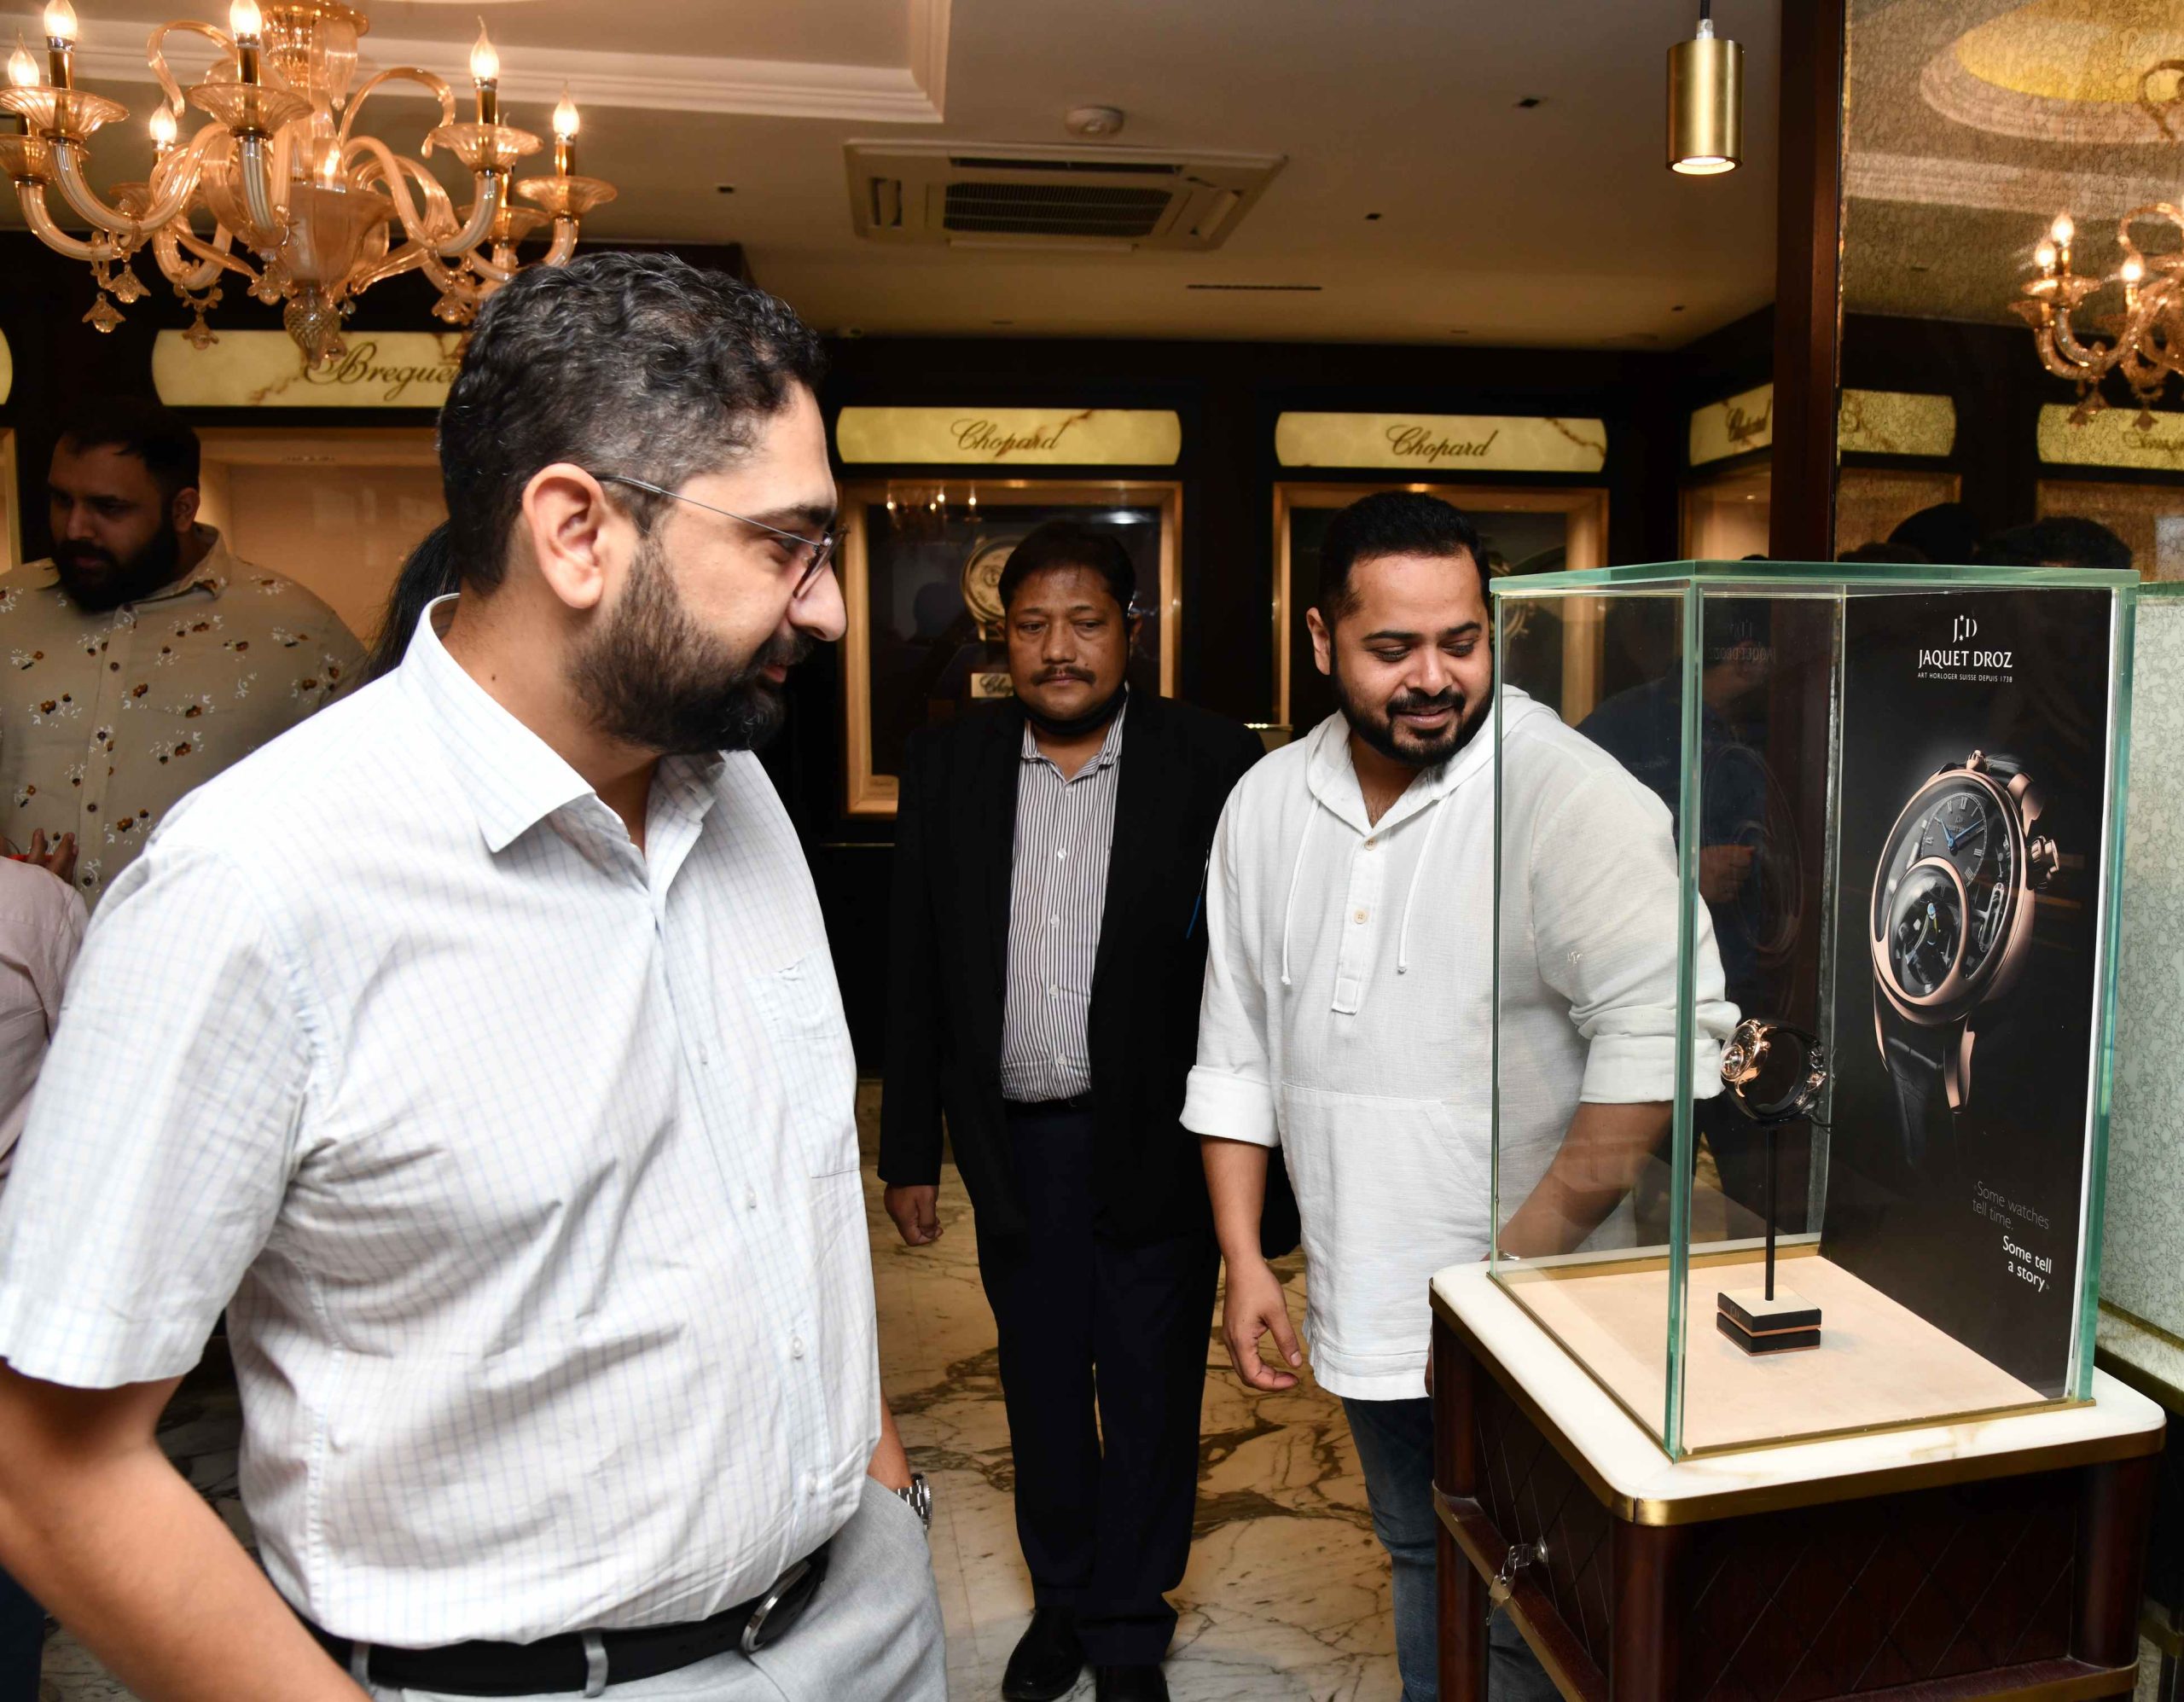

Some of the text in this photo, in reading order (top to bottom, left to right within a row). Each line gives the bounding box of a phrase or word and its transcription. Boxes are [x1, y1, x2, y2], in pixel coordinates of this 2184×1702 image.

[304, 341, 461, 402] Bregue
[950, 417, 1069, 458] Chopard
[1385, 424, 1500, 463] Chopard
[1918, 649, 2013, 670] JAQUET DROZ
[979, 673, 1014, 697] Chop
[1972, 1199, 2013, 1230] tell time.
[1978, 1181, 2049, 1229] Some watches
[2002, 1235, 2052, 1275] Some tell
[2007, 1261, 2045, 1292] a story
